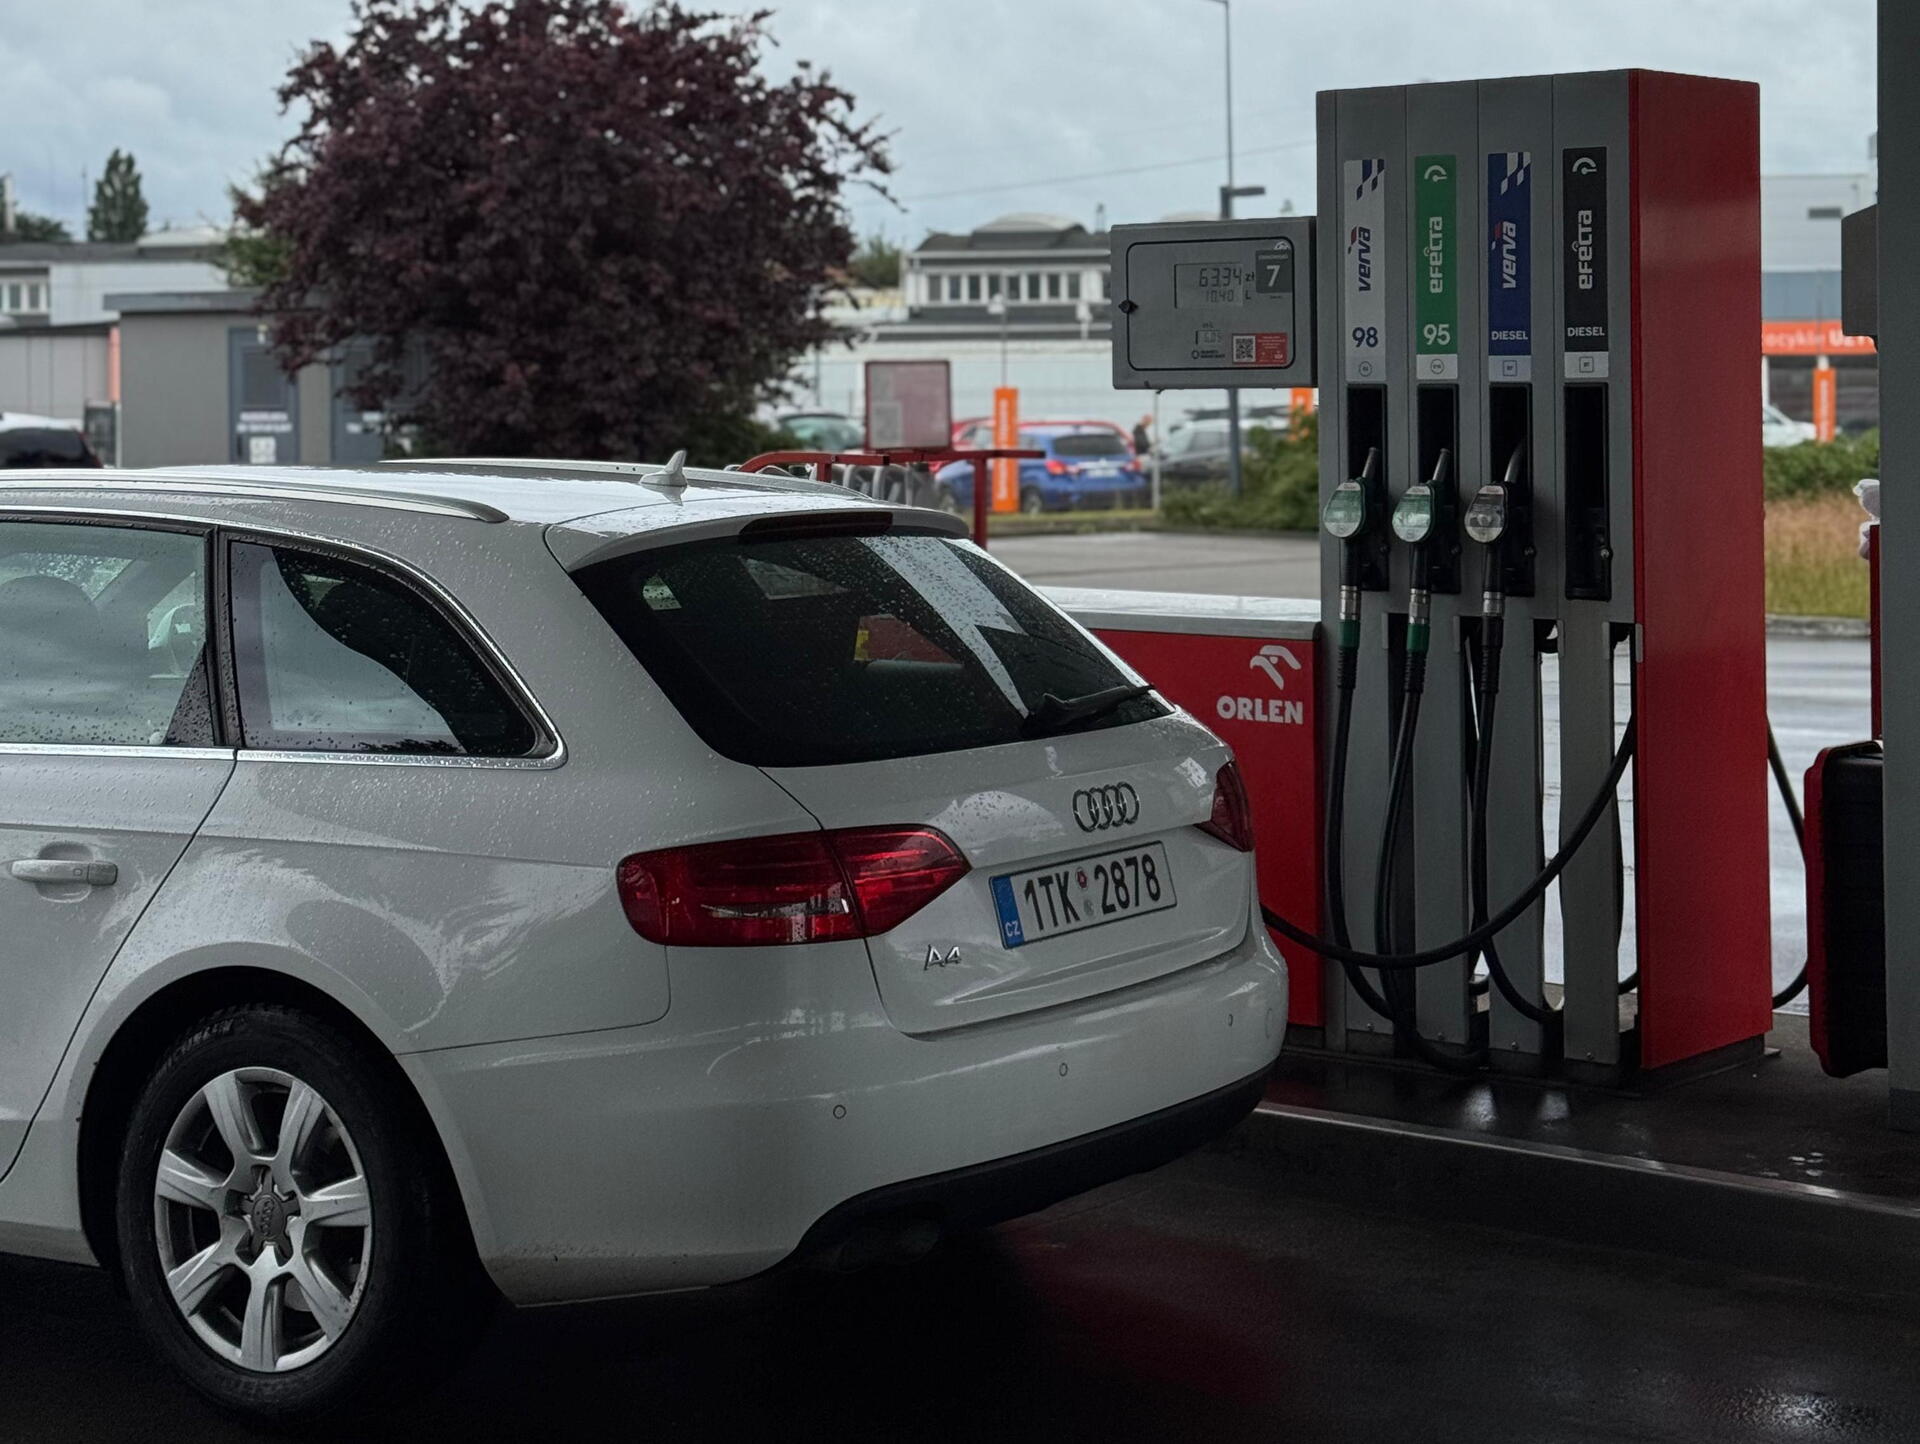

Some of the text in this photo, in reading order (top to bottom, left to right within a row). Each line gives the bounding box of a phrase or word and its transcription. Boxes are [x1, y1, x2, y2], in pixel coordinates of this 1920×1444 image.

[1357, 226, 1372, 292] verva
[1429, 216, 1443, 294] efecta
[1501, 220, 1517, 289] verva
[1577, 209, 1593, 290] efecta
[1266, 264, 1281, 287] 7
[1352, 326, 1379, 348] 98
[1423, 323, 1451, 346] 95
[1491, 330, 1529, 341] DIESEL
[1567, 326, 1605, 337] DIESEL
[1216, 695, 1303, 725] ORLEN
[1024, 854, 1161, 931] 1TK 2878
[1004, 921, 1021, 937] CZ
[923, 943, 960, 971] A4
